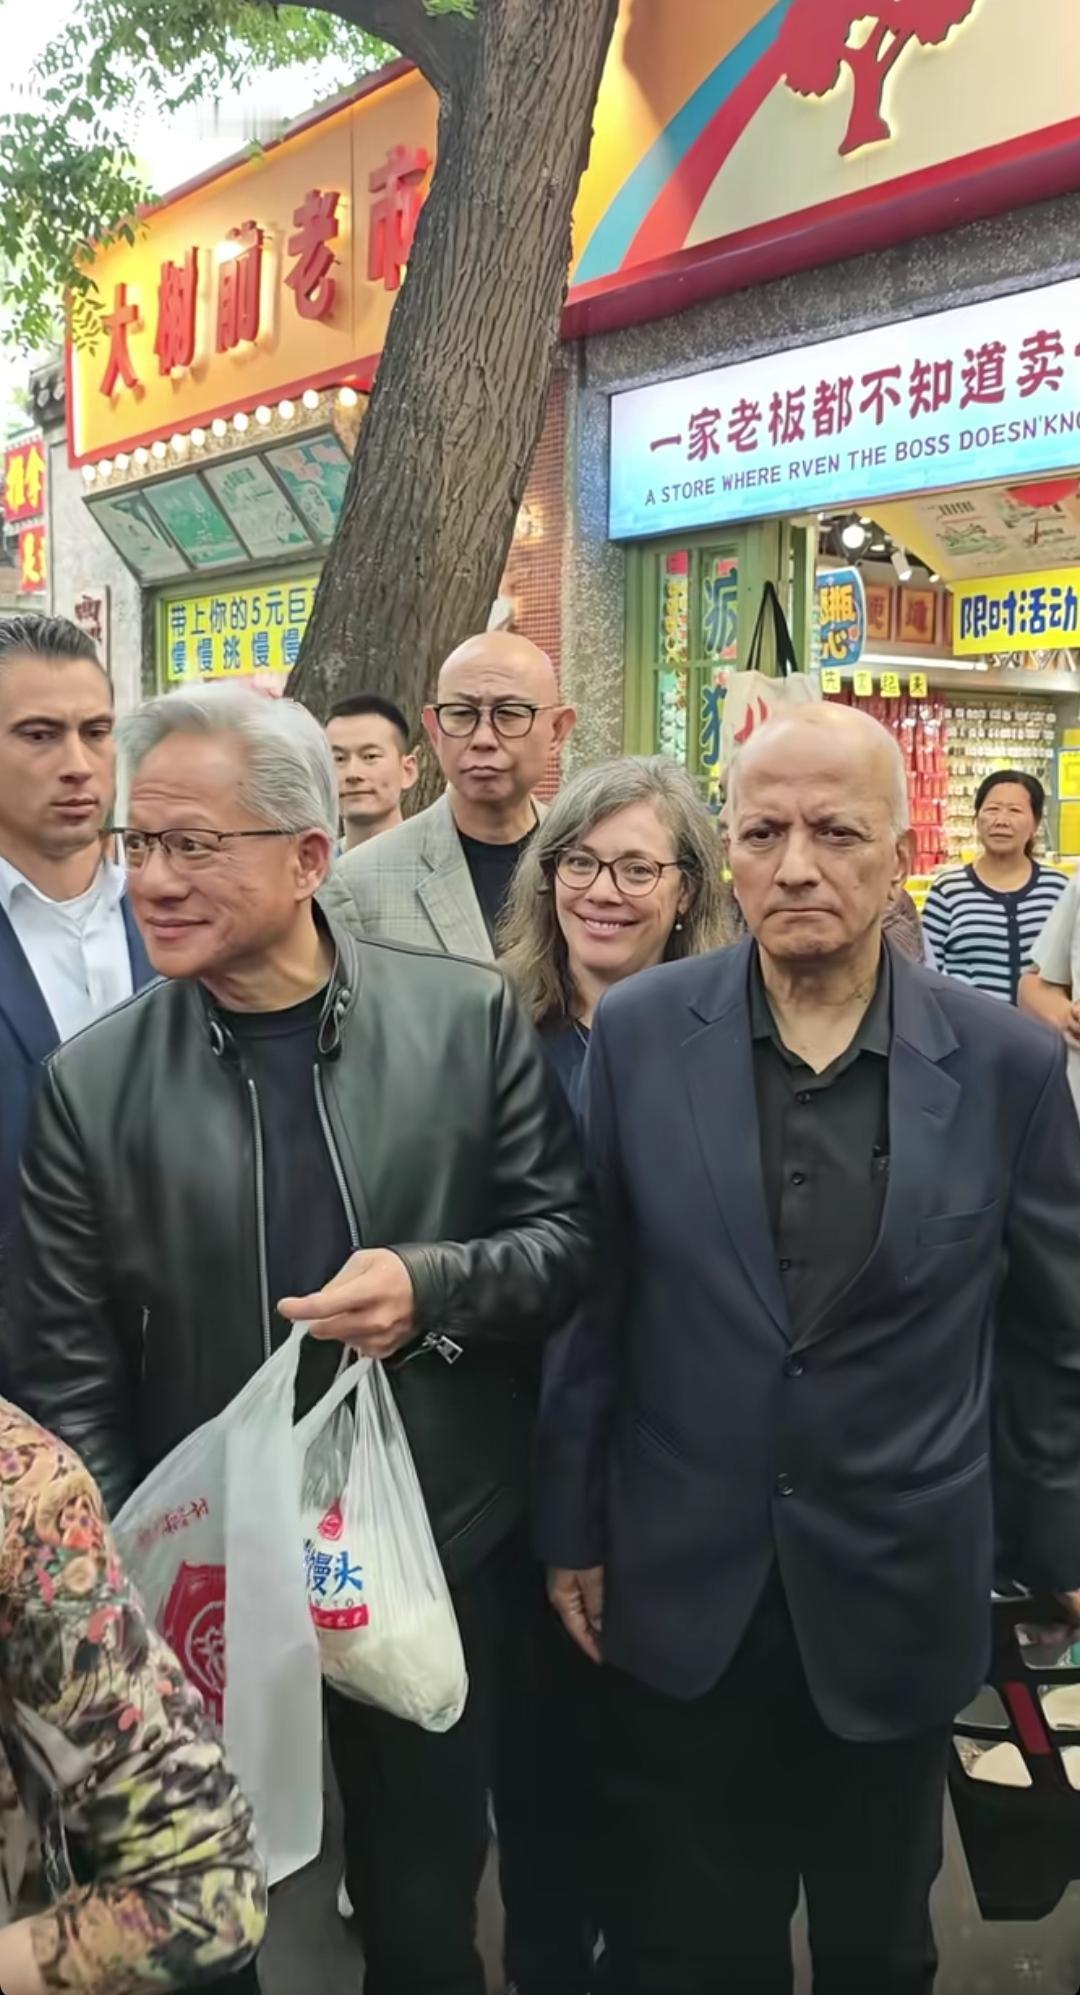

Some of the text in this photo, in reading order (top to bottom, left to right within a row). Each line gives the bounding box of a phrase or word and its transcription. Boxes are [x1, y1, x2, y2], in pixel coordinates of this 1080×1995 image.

[650, 329, 1080, 462] 一家老板都不知道卖
[645, 489, 656, 507] A
[661, 477, 715, 503] STORE
[722, 465, 781, 493] WHERE
[789, 453, 841, 480] RVEN
[847, 445, 887, 471] THE
[895, 434, 950, 462] BOSS
[170, 587, 316, 637] 带上你的5元巨
[960, 586, 1078, 640] 限时活动
[171, 627, 301, 674] 慢慢挑慢慢
